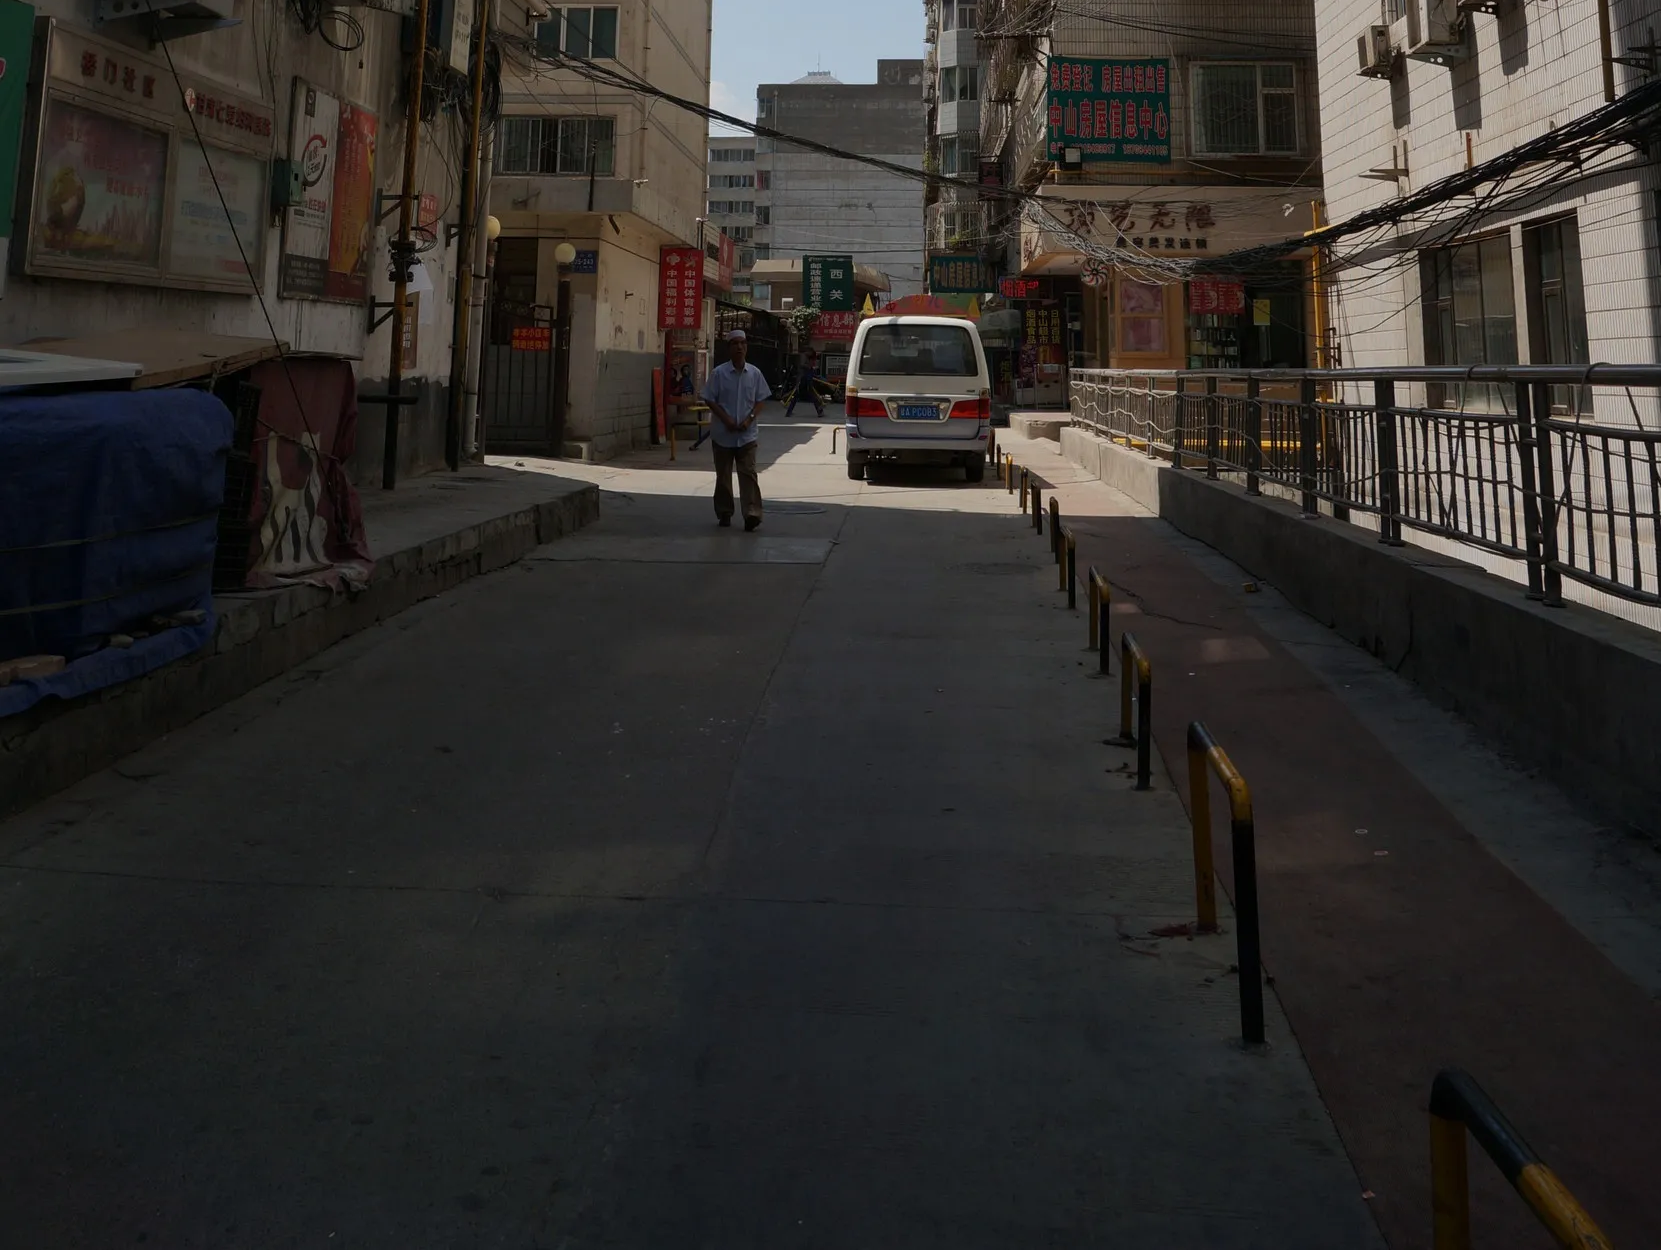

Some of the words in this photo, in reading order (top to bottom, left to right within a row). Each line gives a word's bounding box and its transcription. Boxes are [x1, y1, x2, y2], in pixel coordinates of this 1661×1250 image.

[1050, 62, 1093, 92] 免费登记
[1101, 65, 1166, 93] 房屋出租出售
[1049, 97, 1169, 140] 中山房屋信息中心
[665, 269, 678, 326] 中国福利彩票
[683, 269, 696, 326] 中国体育彩票
[829, 268, 844, 301] 西关
[1038, 309, 1049, 345] 中山超市
